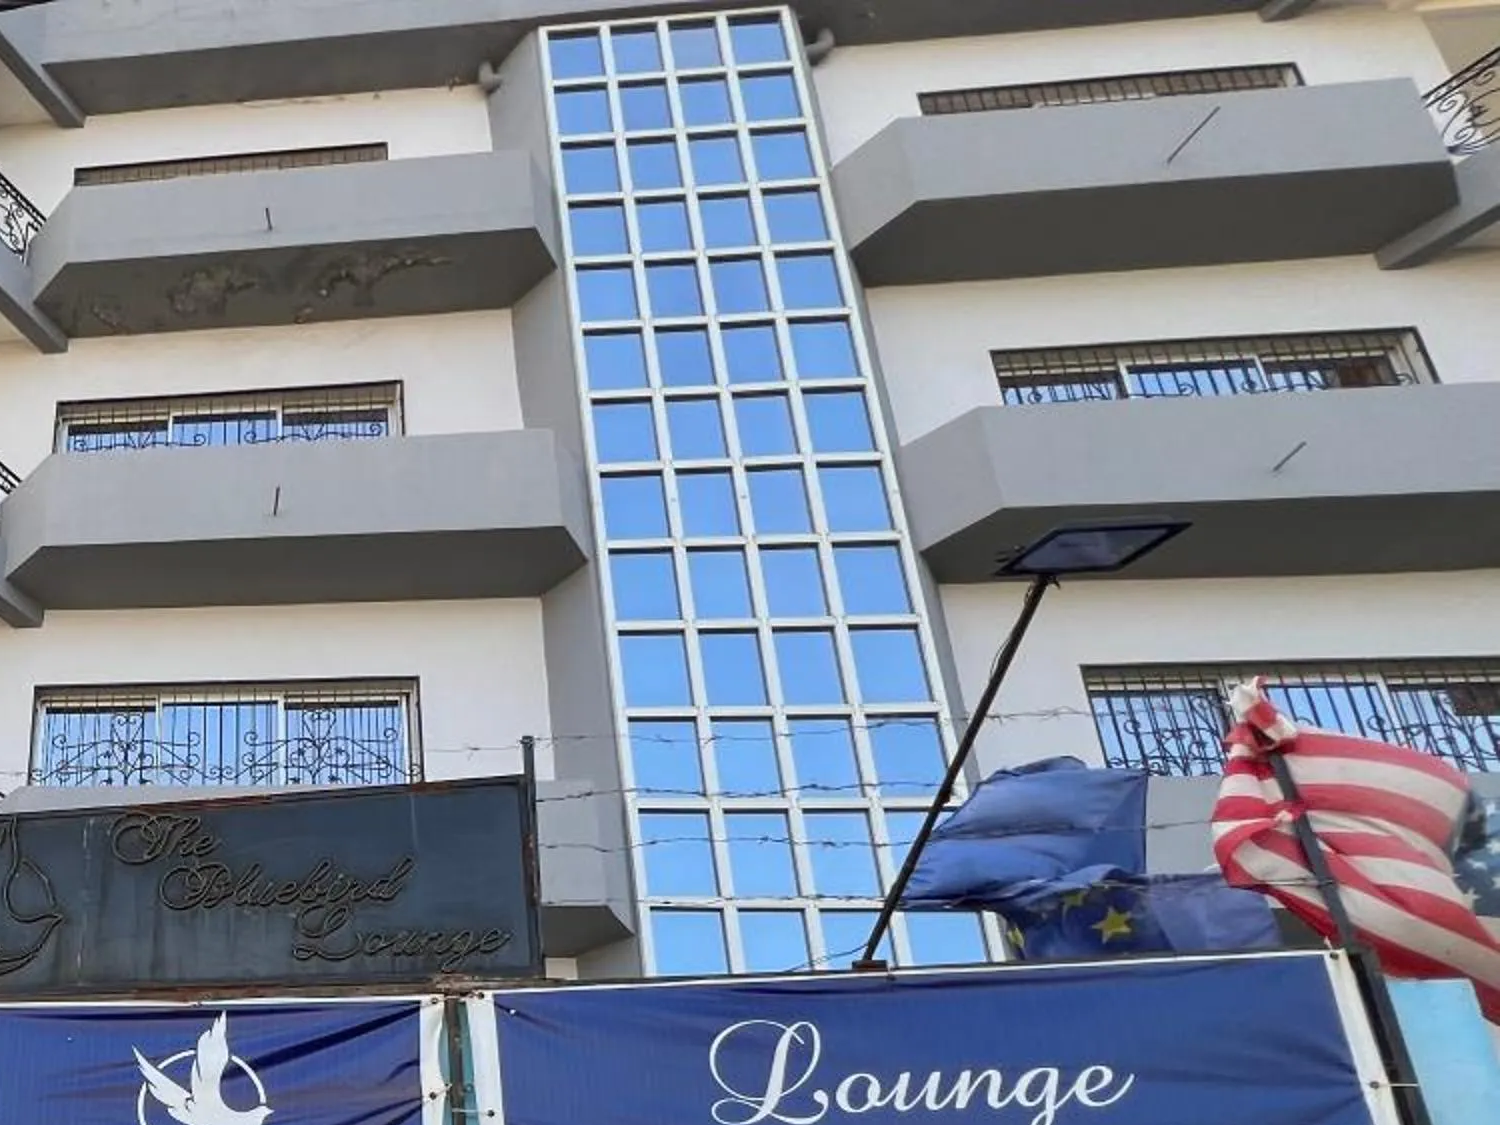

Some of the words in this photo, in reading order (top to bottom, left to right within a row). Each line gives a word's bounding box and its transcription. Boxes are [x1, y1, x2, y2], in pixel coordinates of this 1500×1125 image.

[111, 813, 221, 863] The
[158, 856, 417, 911] Bluebird
[292, 904, 511, 972] Lounge
